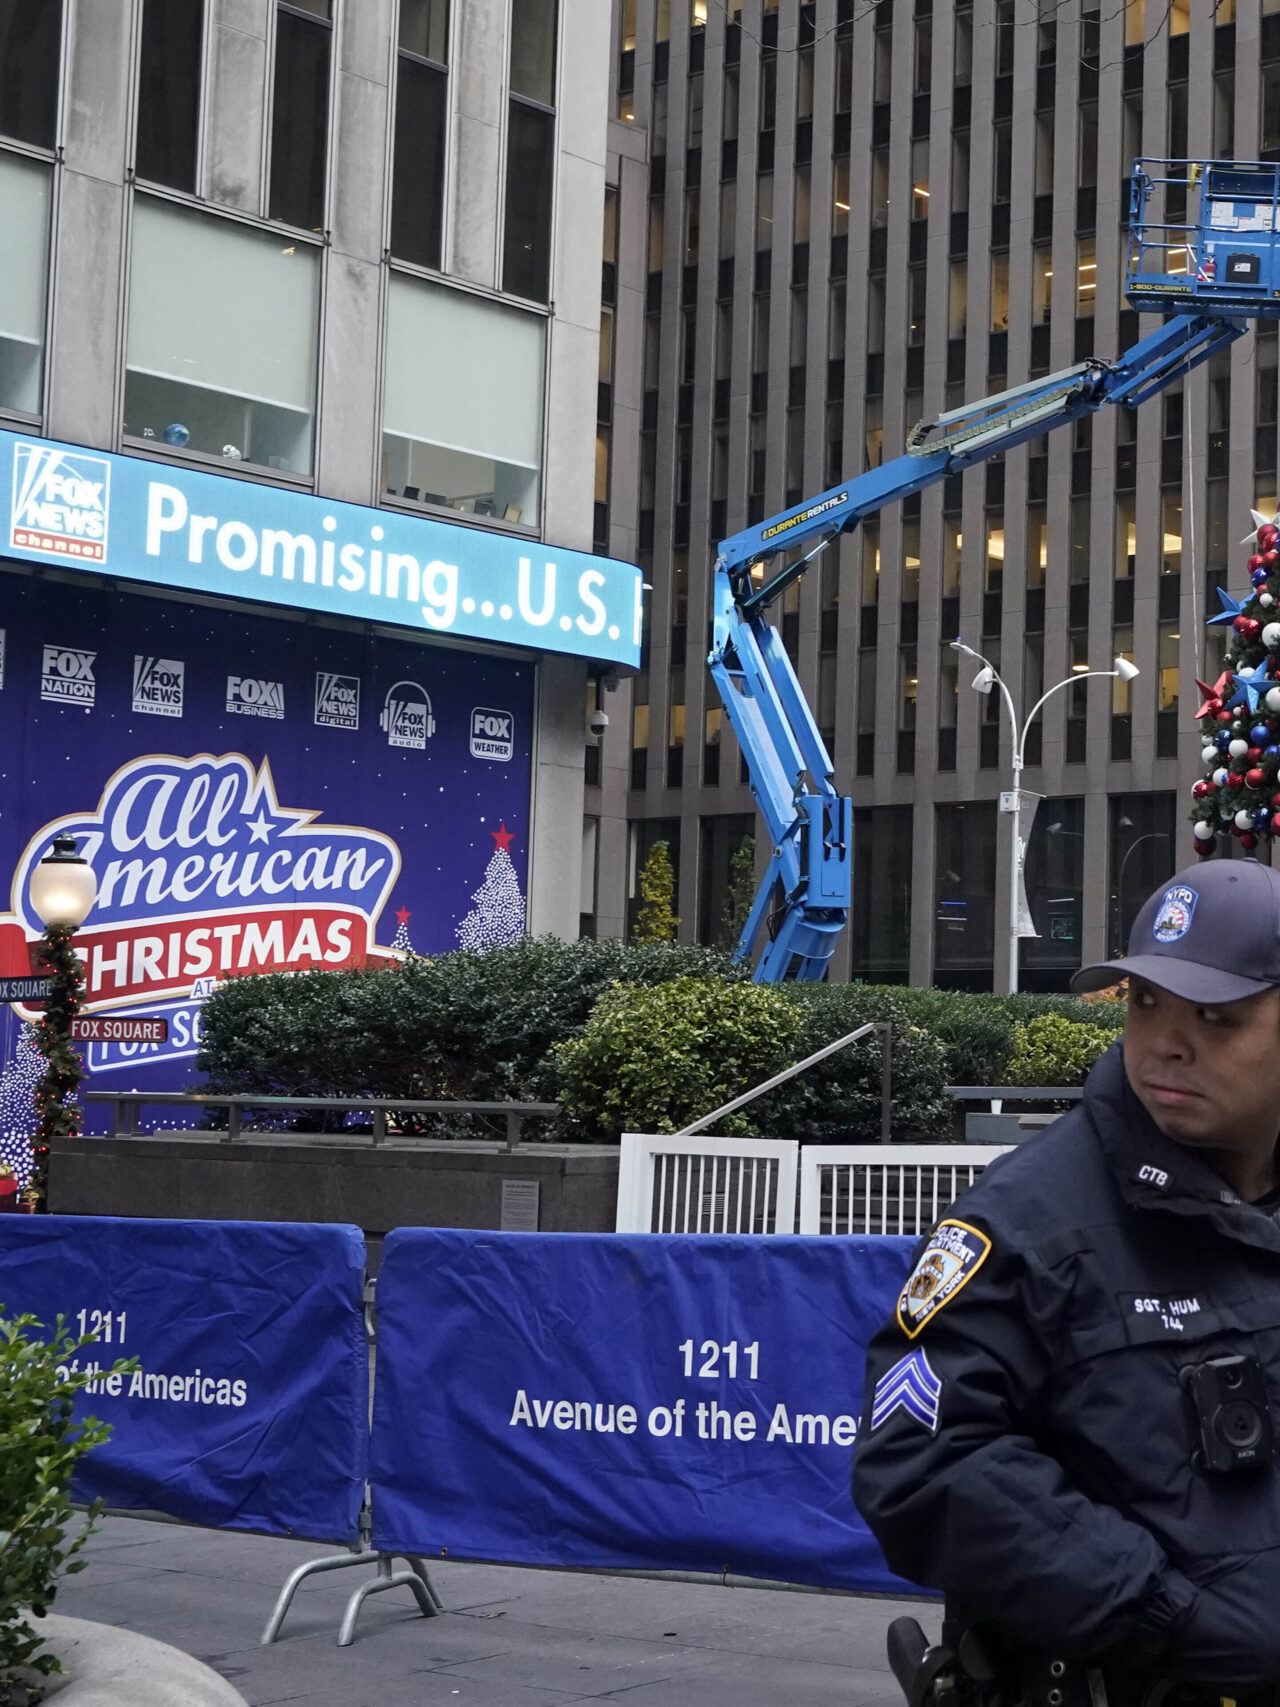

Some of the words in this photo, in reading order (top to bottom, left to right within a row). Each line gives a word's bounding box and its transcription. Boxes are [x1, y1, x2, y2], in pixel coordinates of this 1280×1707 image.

[44, 474, 105, 513] FOX
[26, 500, 105, 538] NEWS
[15, 533, 103, 558] channel
[42, 649, 96, 681] FOX
[41, 678, 96, 698] NATION
[150, 670, 181, 688] FOX
[140, 685, 181, 704] NEWS
[227, 675, 277, 707] FOX
[330, 686, 356, 703] FOX
[134, 703, 181, 716] channel
[225, 703, 285, 720] BUSINESS
[322, 700, 356, 717] NEWS
[319, 716, 355, 727] digital
[402, 712, 424, 727] FOX
[474, 714, 510, 739] FOX
[394, 725, 425, 739] NEWS
[392, 739, 423, 749] audio
[474, 741, 509, 756] WEATHER
[11, 980, 53, 998] SQUARE
[192, 979, 214, 997] AT
[71, 1021, 100, 1038] FOX
[103, 1021, 162, 1039] SQUARE
[1138, 1165, 1169, 1187] CTB
[936, 1270, 966, 1300] YORK
[1134, 1299, 1166, 1313] SGT.
[1169, 1298, 1200, 1316] HUM
[76, 1308, 127, 1344] 1211
[678, 1339, 759, 1380] 1211
[128, 1368, 248, 1407] Americas
[509, 1389, 638, 1435] Avenue
[647, 1398, 686, 1437] of
[695, 1400, 757, 1440] the
[765, 1403, 862, 1446] Ame
